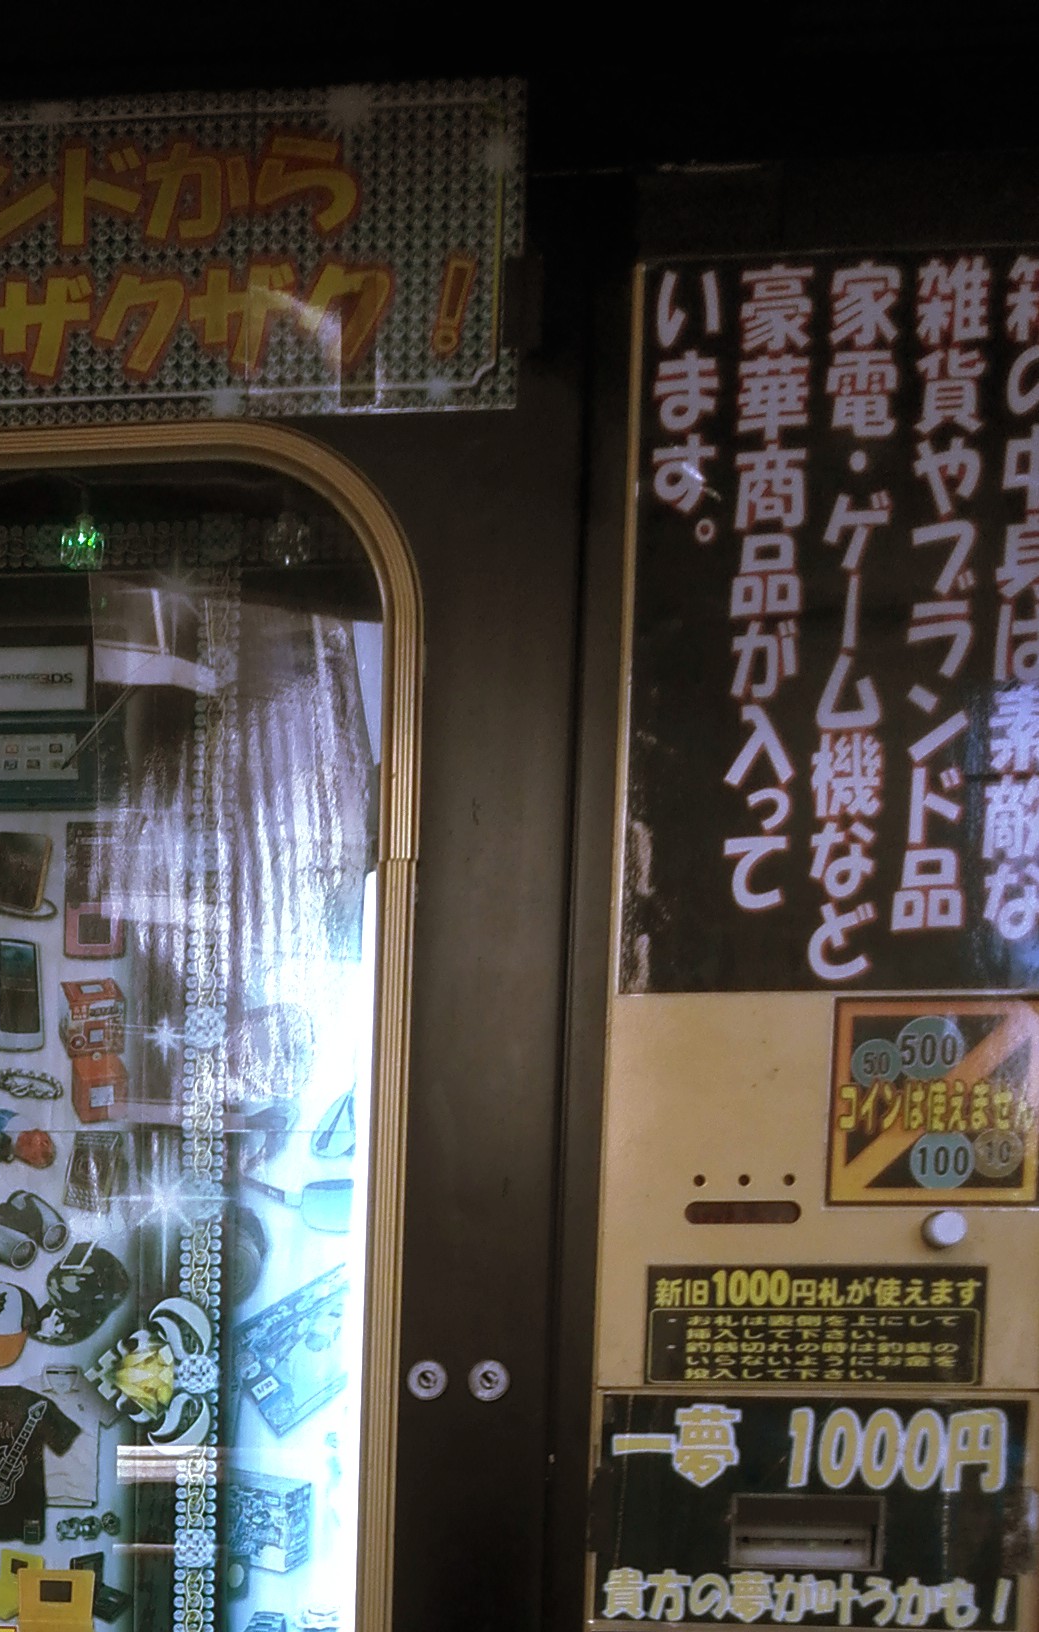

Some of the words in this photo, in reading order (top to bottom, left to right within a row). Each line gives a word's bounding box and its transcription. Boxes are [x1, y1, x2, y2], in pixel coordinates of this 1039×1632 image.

[651, 271, 723, 545] います。
[723, 266, 815, 912] 豪華商品が入って
[892, 256, 992, 932] 雑貨やブランド品
[807, 260, 902, 982] 家電・ゲーム機など
[862, 1051, 891, 1075] 50
[901, 1033, 958, 1067] 500
[839, 1079, 1035, 1136] コインは使えません
[916, 1146, 969, 1177] 100
[983, 1140, 1012, 1165] 10
[654, 1270, 983, 1307] 新旧1000円札が使えます
[612, 1403, 743, 1488] 一夢
[787, 1407, 1008, 1493] 1000円
